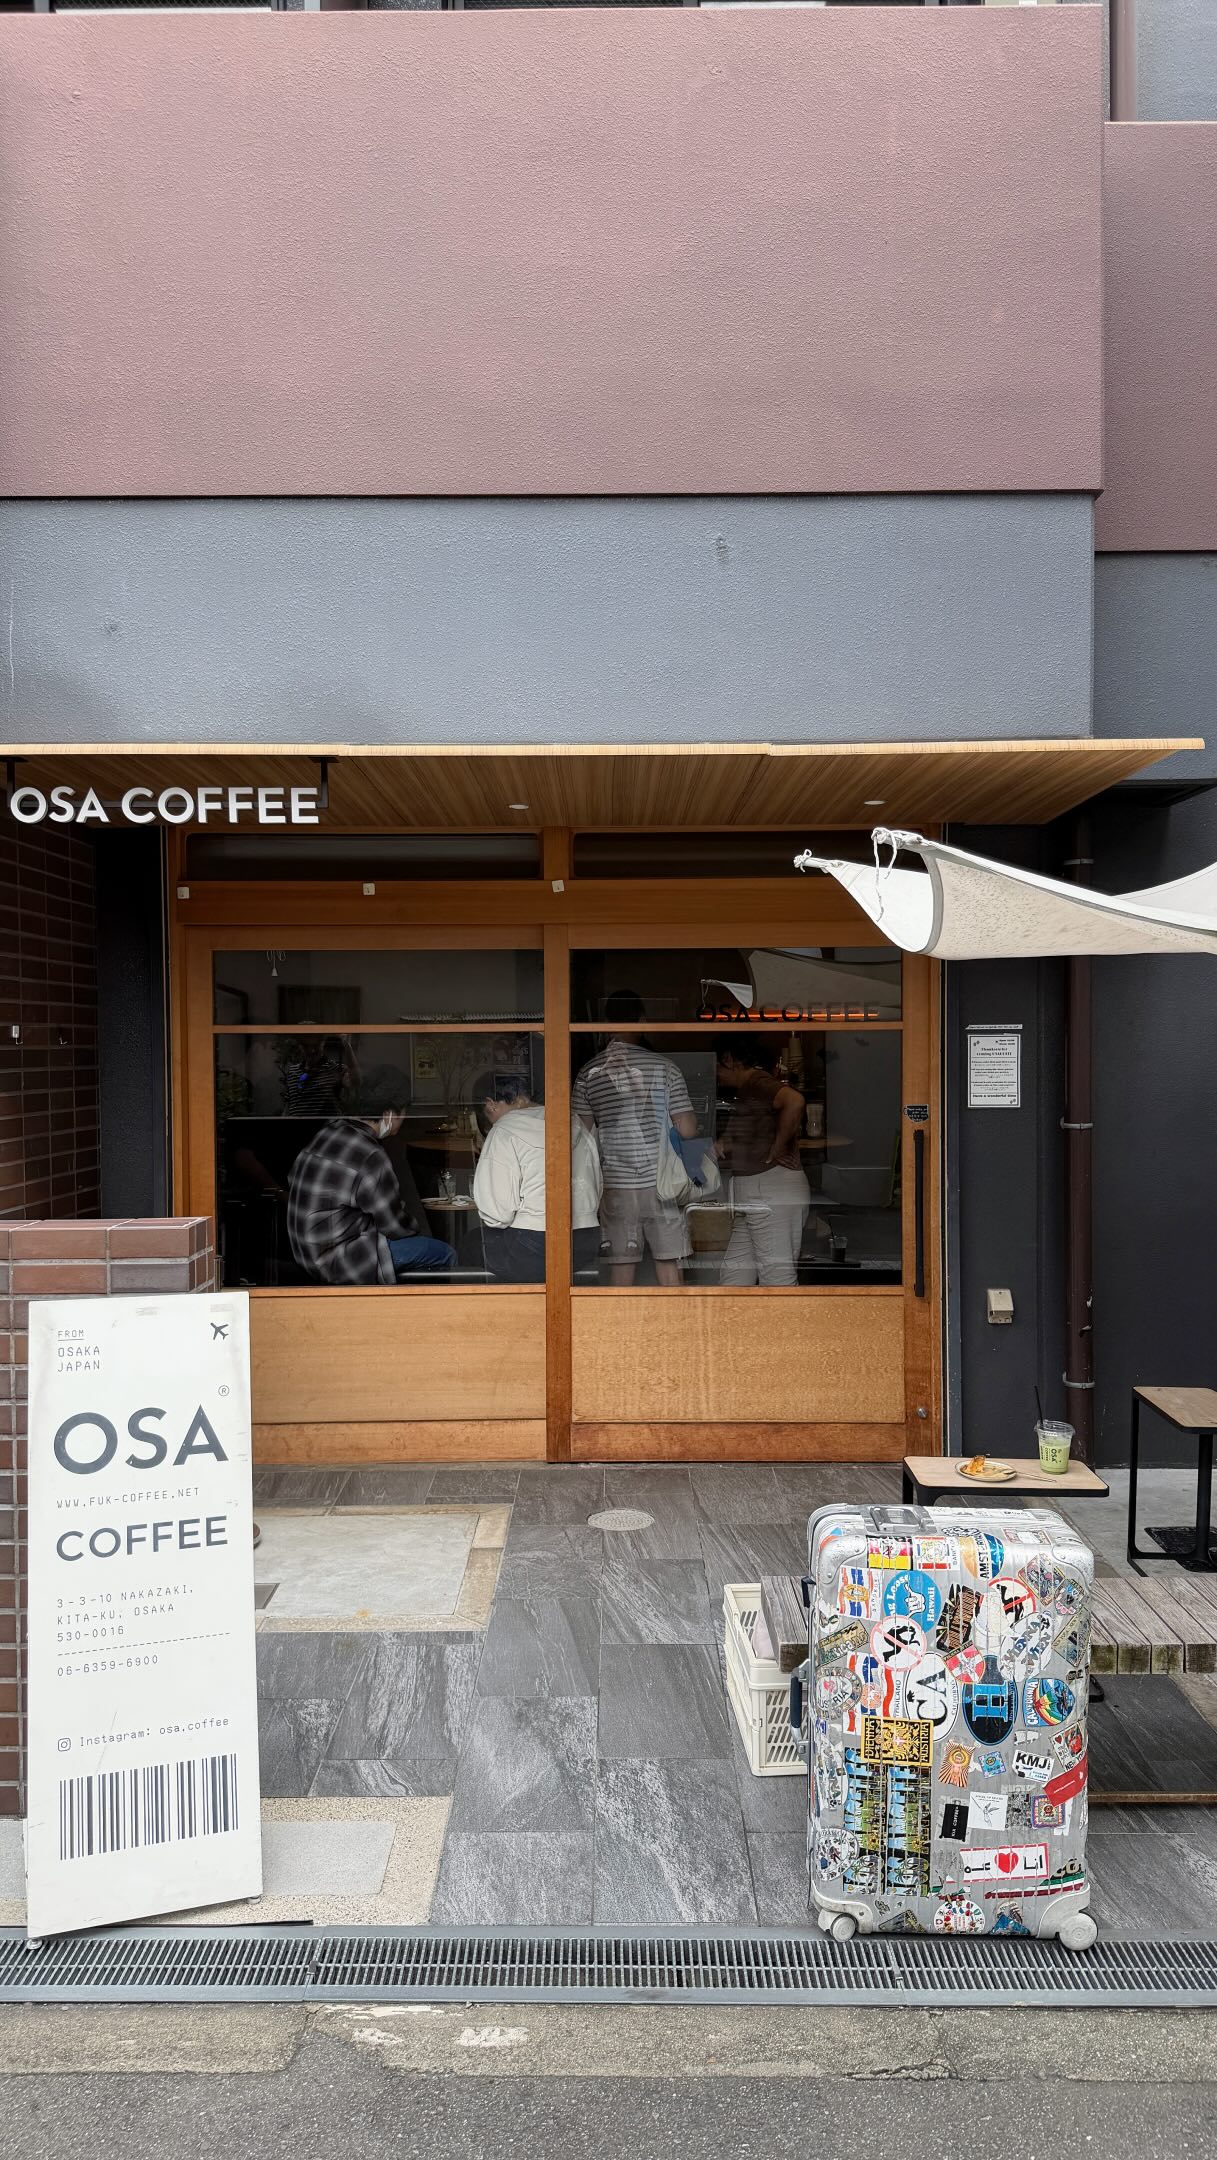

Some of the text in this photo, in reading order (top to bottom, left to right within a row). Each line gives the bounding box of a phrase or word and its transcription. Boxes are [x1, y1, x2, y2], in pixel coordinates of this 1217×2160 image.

[10, 786, 320, 824] OSA COFFEE
[696, 1001, 880, 1022] OSA COFFEE
[57, 1329, 84, 1339] FROM
[57, 1345, 100, 1358] OSAKA
[57, 1359, 101, 1372] JAPAN
[53, 1403, 229, 1475] OSA
[57, 1487, 200, 1509] WWW.FUK-COFFEE.NET
[56, 1515, 228, 1561] COFFEE
[121, 1584, 194, 1600] NAKAZAKI,
[57, 1602, 175, 1625] KITA-KU, OSAKA
[926, 1586, 935, 1622] Hawaii
[57, 1625, 125, 1642] 530-0016
[57, 1655, 158, 1677] 06-6359-6900
[915, 1668, 947, 1726] CA
[1026, 1680, 1039, 1725] CALIFORNIA
[80, 1717, 229, 1747] Instagram: osa.coffee
[920, 1721, 929, 1760] AUSTRIA
[1015, 1752, 1048, 1770] KMJ
